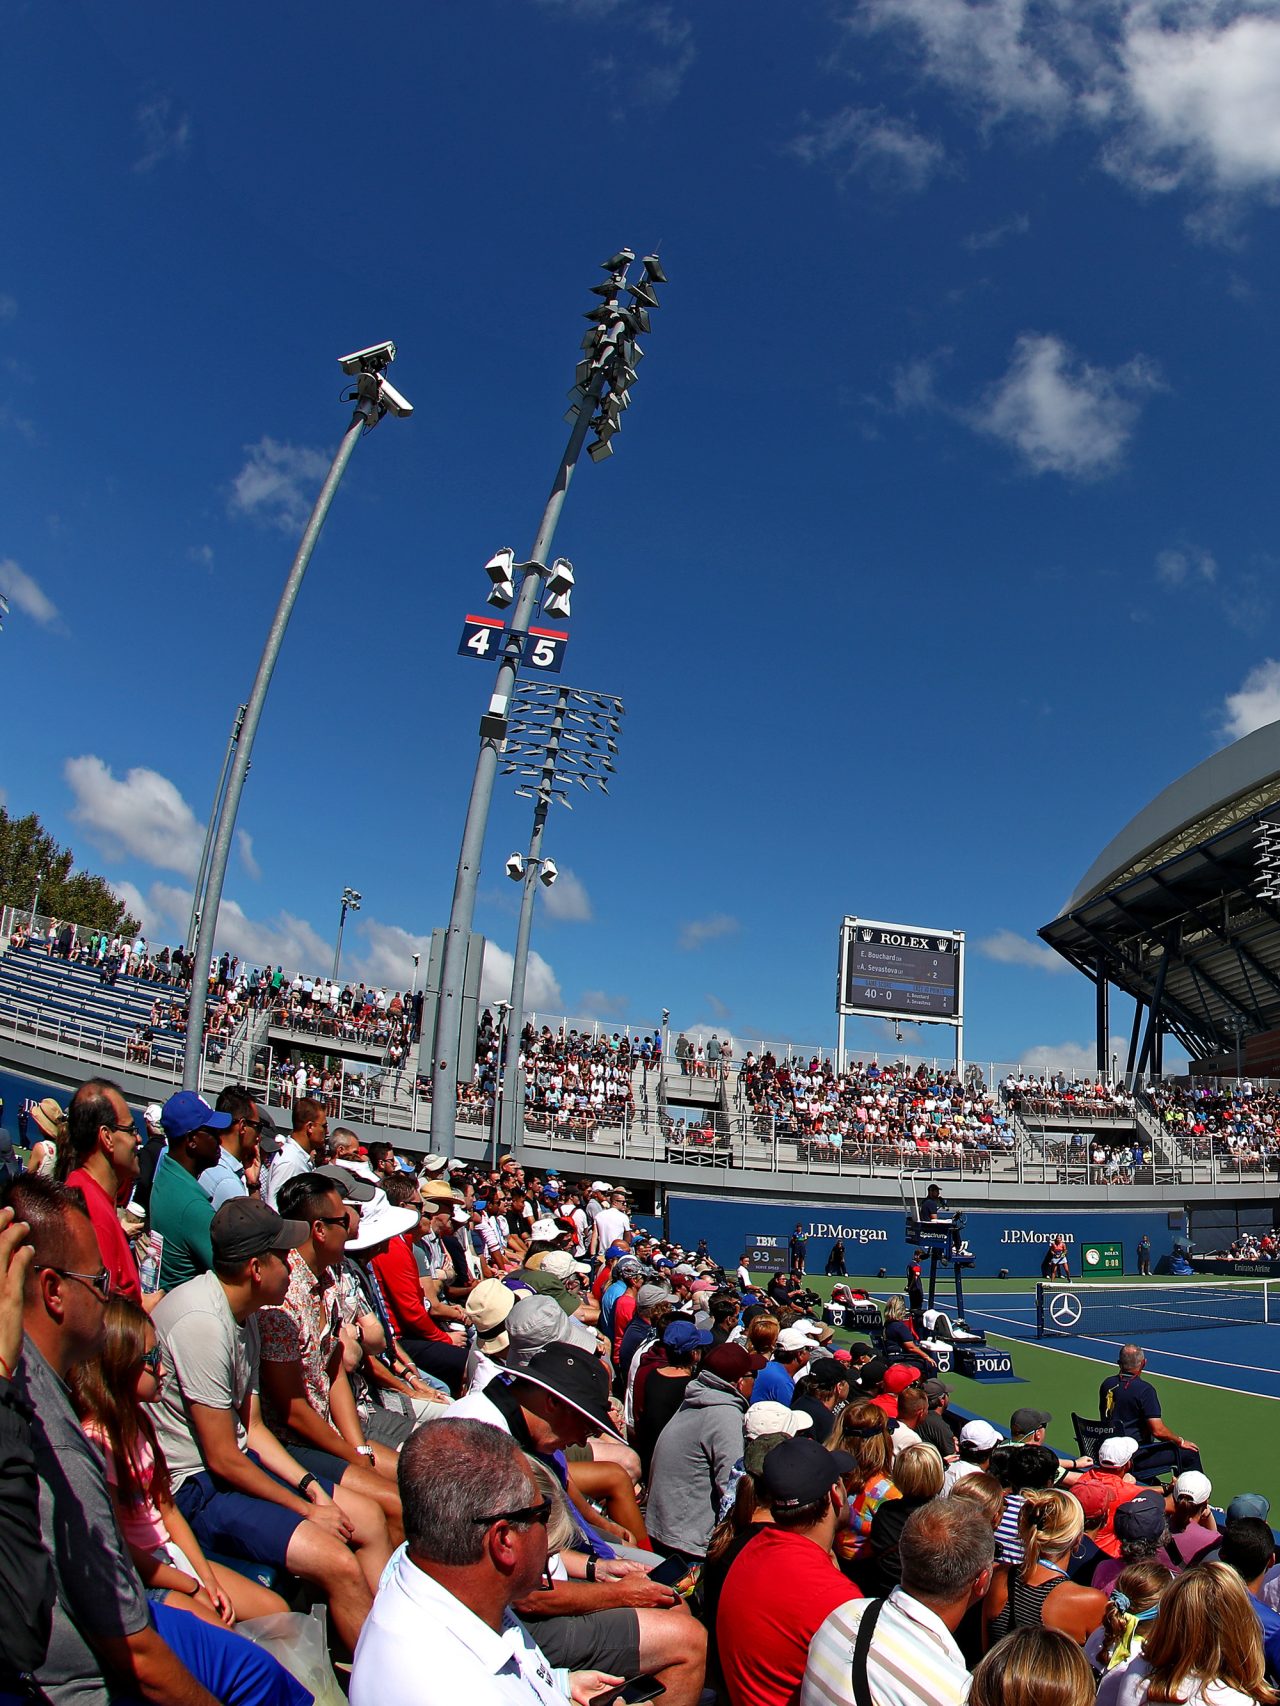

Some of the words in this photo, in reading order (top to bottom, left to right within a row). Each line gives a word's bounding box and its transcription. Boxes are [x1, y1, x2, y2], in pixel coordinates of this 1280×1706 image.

[467, 628, 490, 655] 4
[531, 638, 556, 666] 5
[880, 932, 929, 949] ROLEX
[868, 951, 896, 961] Bouchard
[868, 964, 898, 974] Sevastova
[864, 988, 877, 999] 40
[886, 990, 892, 1000] 0
[805, 1222, 888, 1244] J.P.Morgan
[919, 1231, 946, 1239] Spectrum
[1000, 1229, 1075, 1246] J.P.Morgan
[756, 1236, 778, 1247] IBM
[752, 1251, 770, 1262] 93
[1234, 1263, 1254, 1273] Emirates
[1254, 1264, 1271, 1273] Airline
[856, 1314, 881, 1324] POLO
[976, 1358, 1011, 1372] POLO
[1094, 1427, 1114, 1435] open
